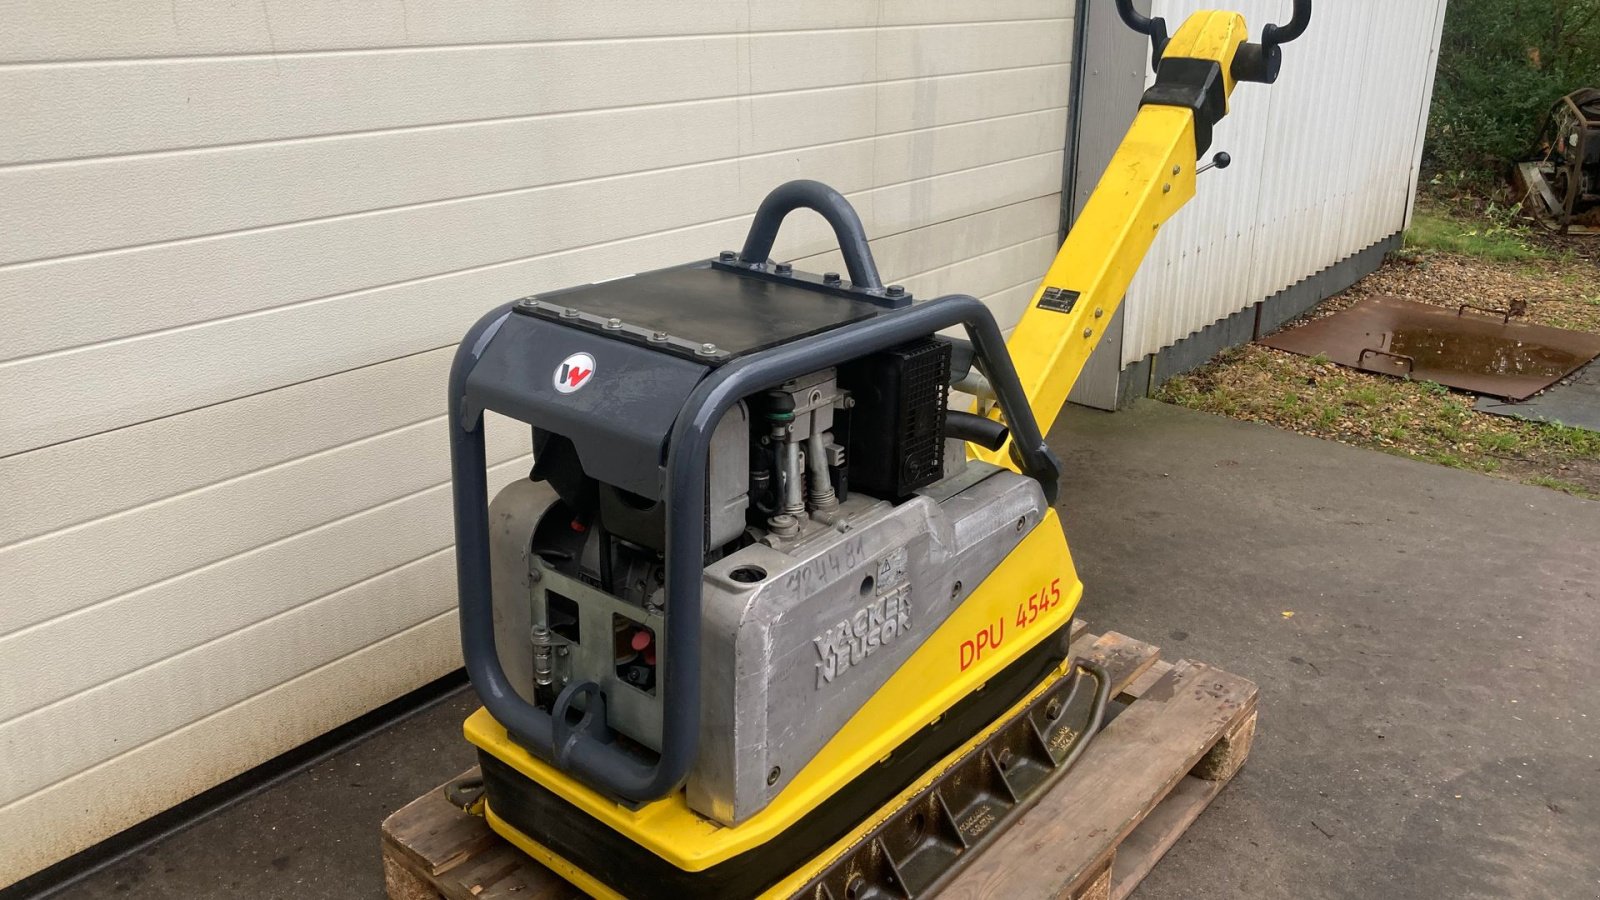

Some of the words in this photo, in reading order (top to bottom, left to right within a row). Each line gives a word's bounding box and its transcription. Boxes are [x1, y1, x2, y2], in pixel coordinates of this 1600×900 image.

[813, 582, 912, 662] WACKER
[814, 604, 912, 691] NEUSON
[960, 617, 1004, 672] DPU
[1016, 578, 1060, 628] 4545
